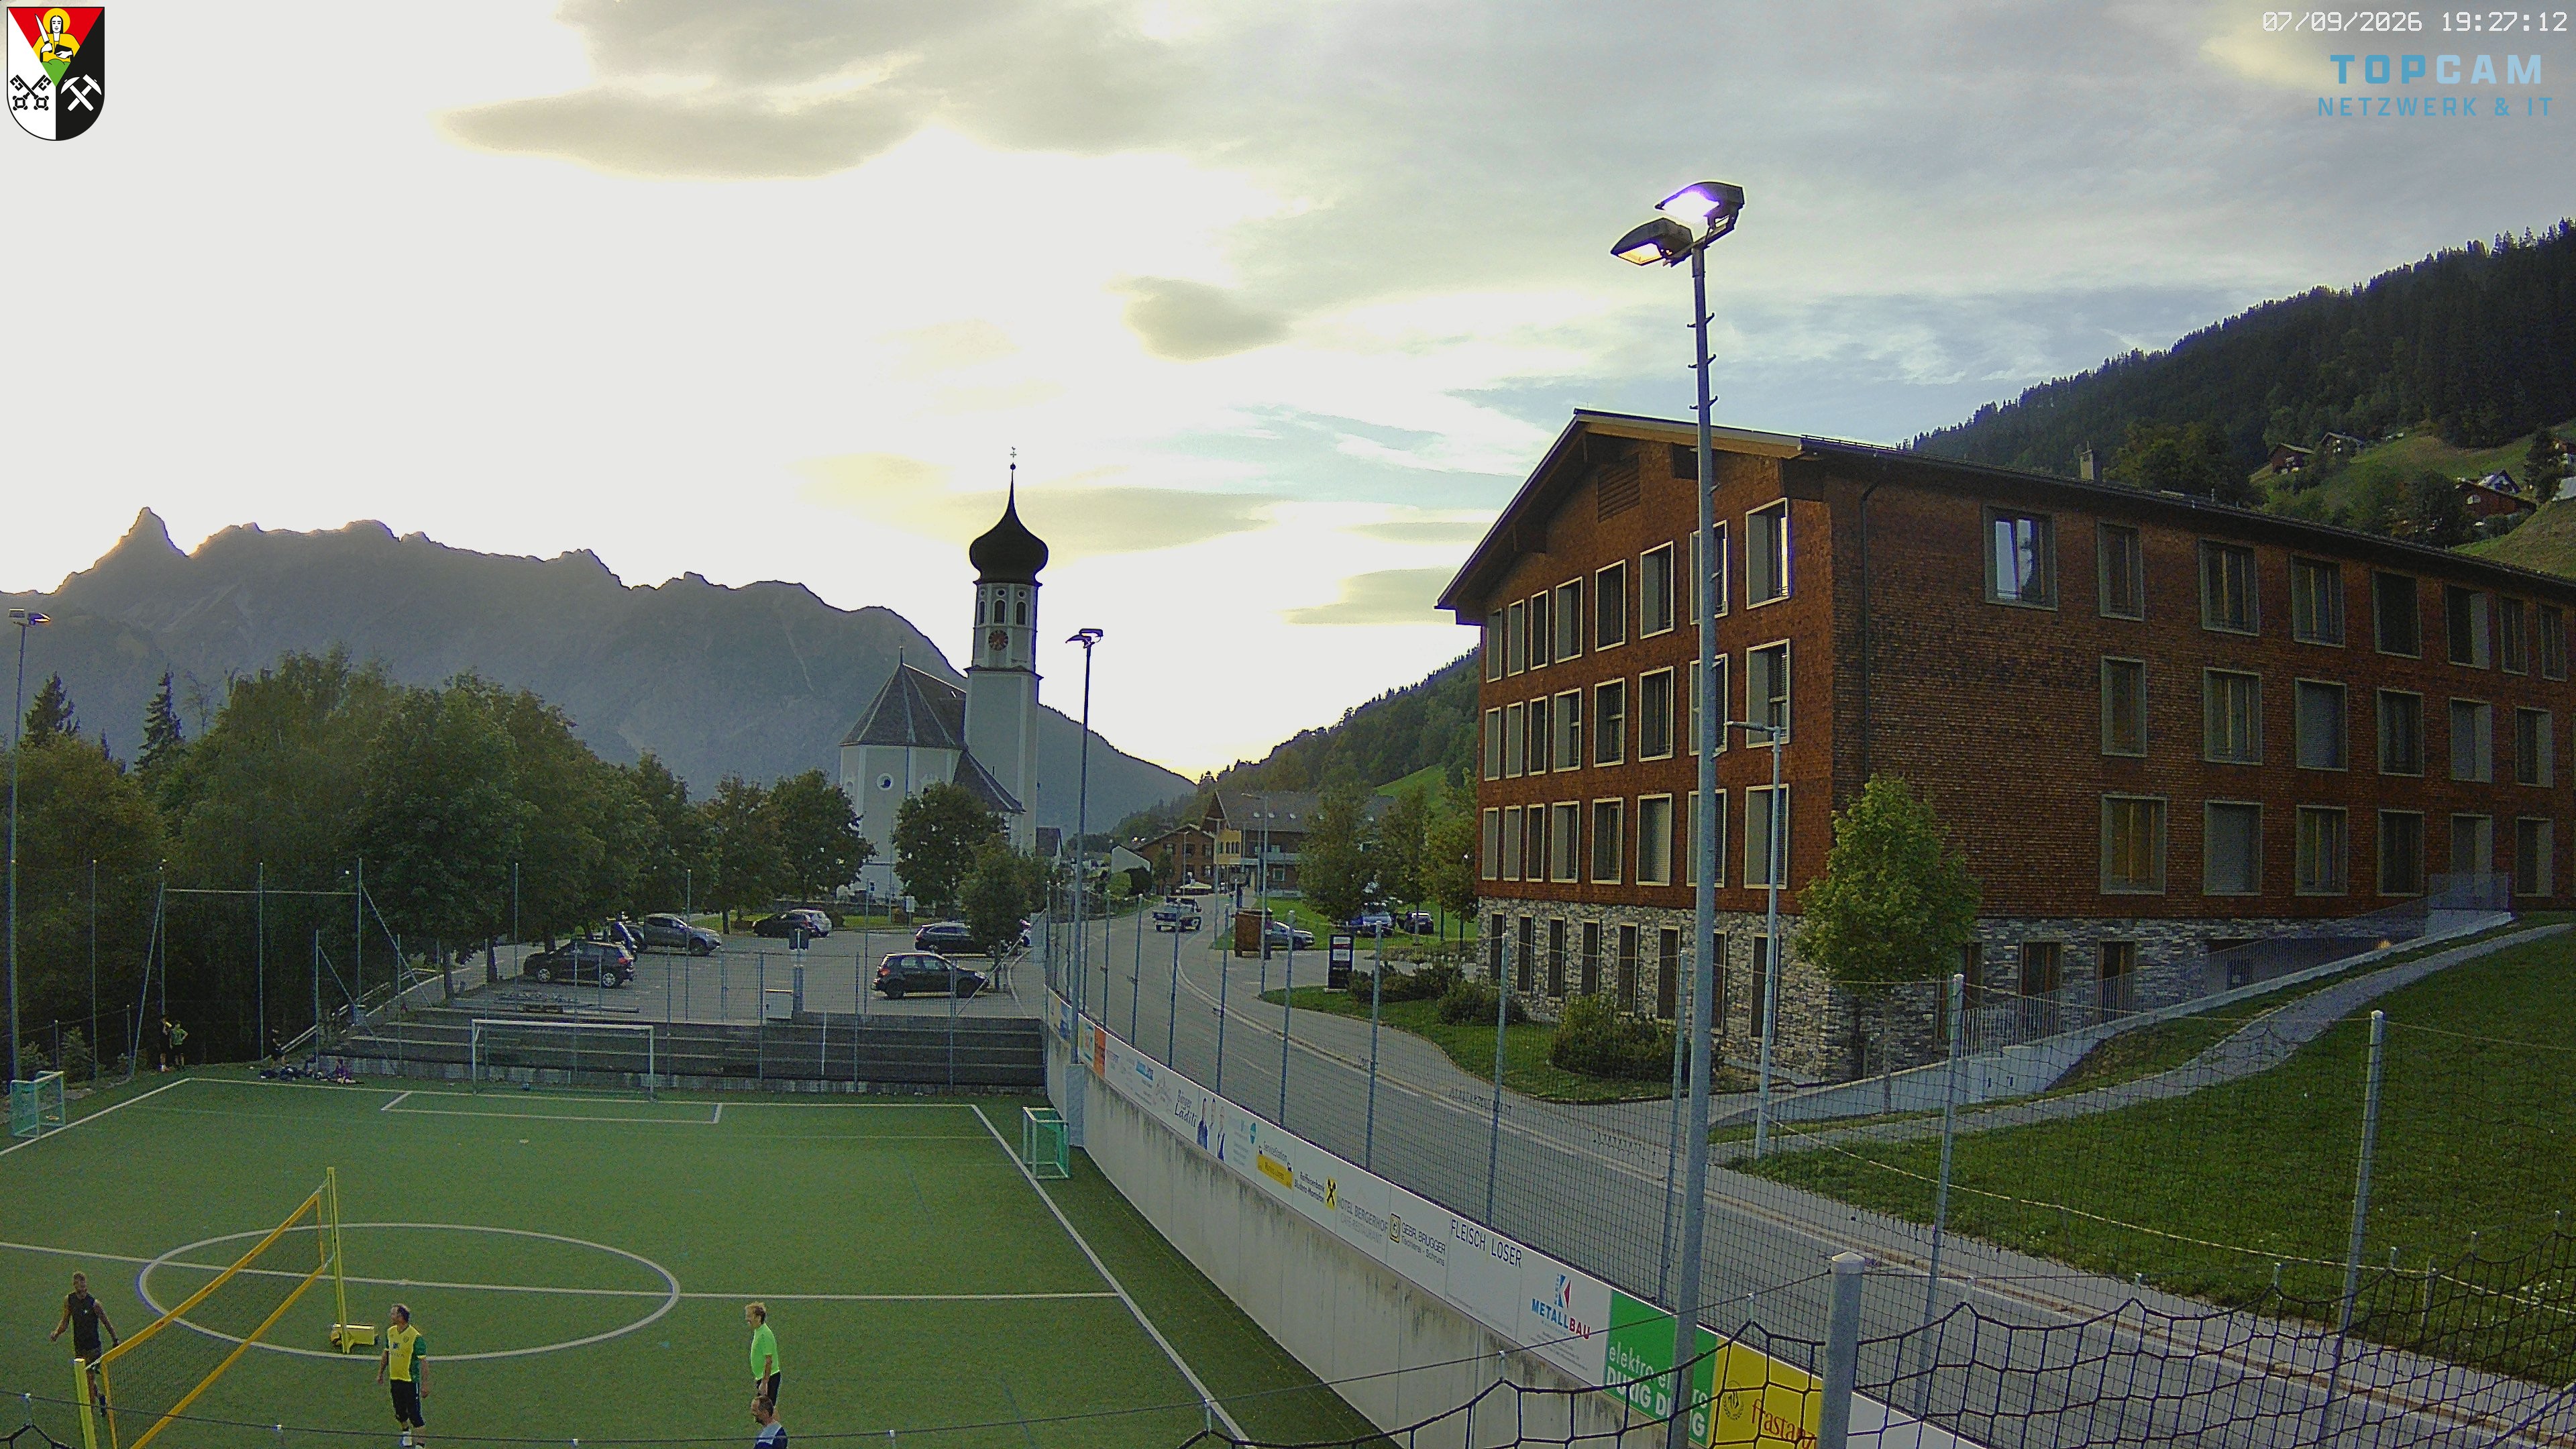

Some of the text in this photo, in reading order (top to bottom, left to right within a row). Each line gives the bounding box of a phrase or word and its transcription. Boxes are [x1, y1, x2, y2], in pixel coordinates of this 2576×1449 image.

[1338, 1196, 1353, 1215] HOTEL
[1355, 1205, 1388, 1232] BERGERHOF
[1401, 1222, 1417, 1240] GEBR.
[1451, 1219, 1522, 1268] FLEISCH LOSER
[1532, 1298, 1591, 1340] METALLBAU
[1609, 1342, 1654, 1377] elektro
